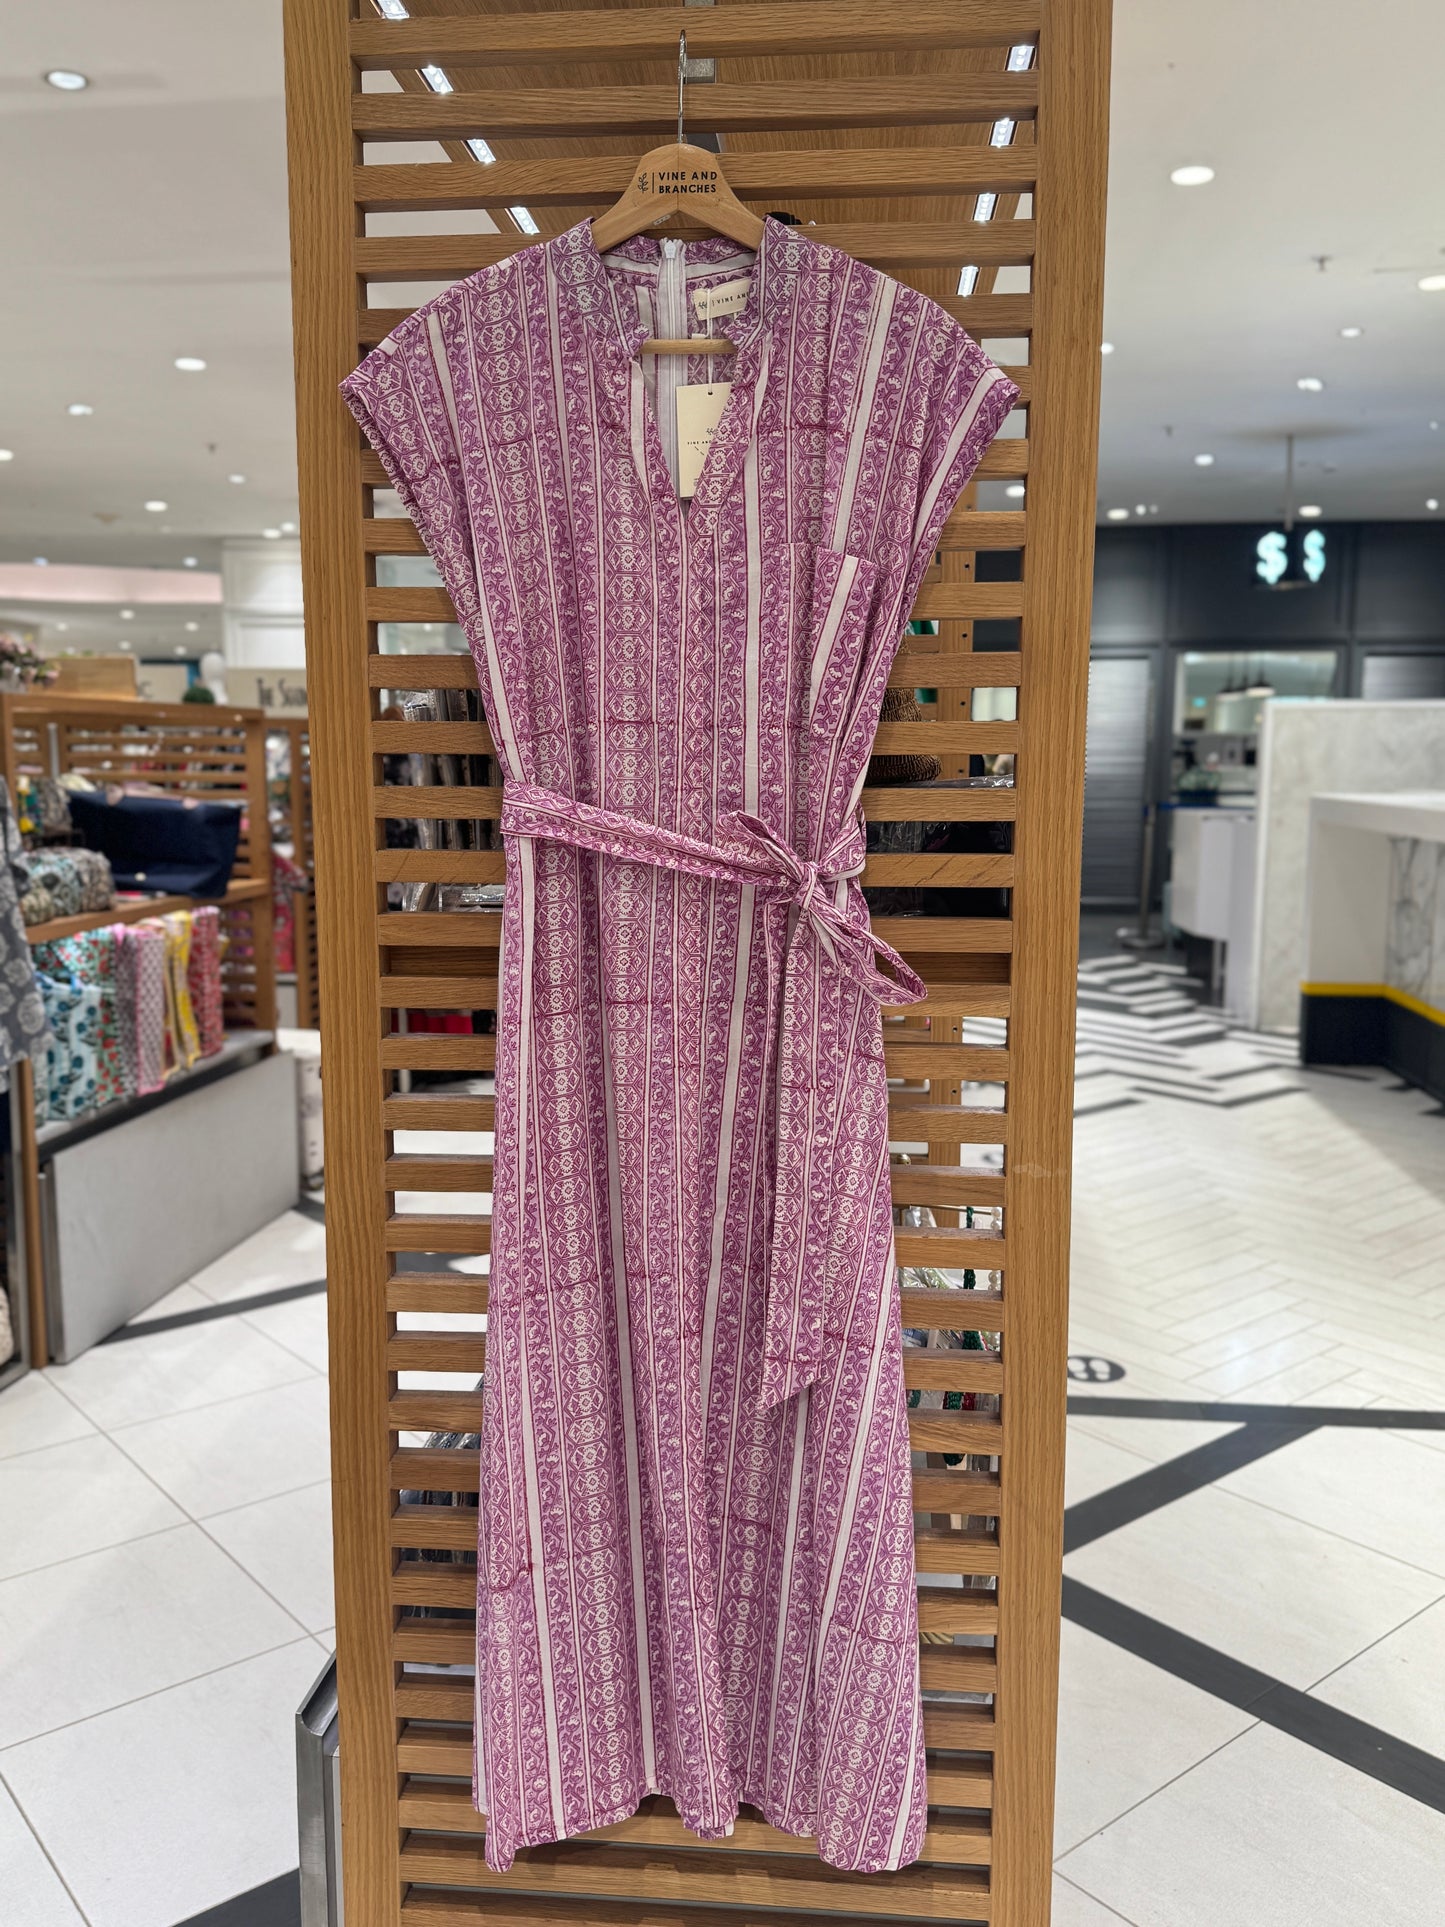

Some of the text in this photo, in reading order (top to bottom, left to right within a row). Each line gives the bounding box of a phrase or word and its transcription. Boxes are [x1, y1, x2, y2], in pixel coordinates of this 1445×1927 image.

[658, 171, 718, 181] VINE AND
[658, 184, 717, 194] BRANCHES
[717, 295, 733, 304] VINE
